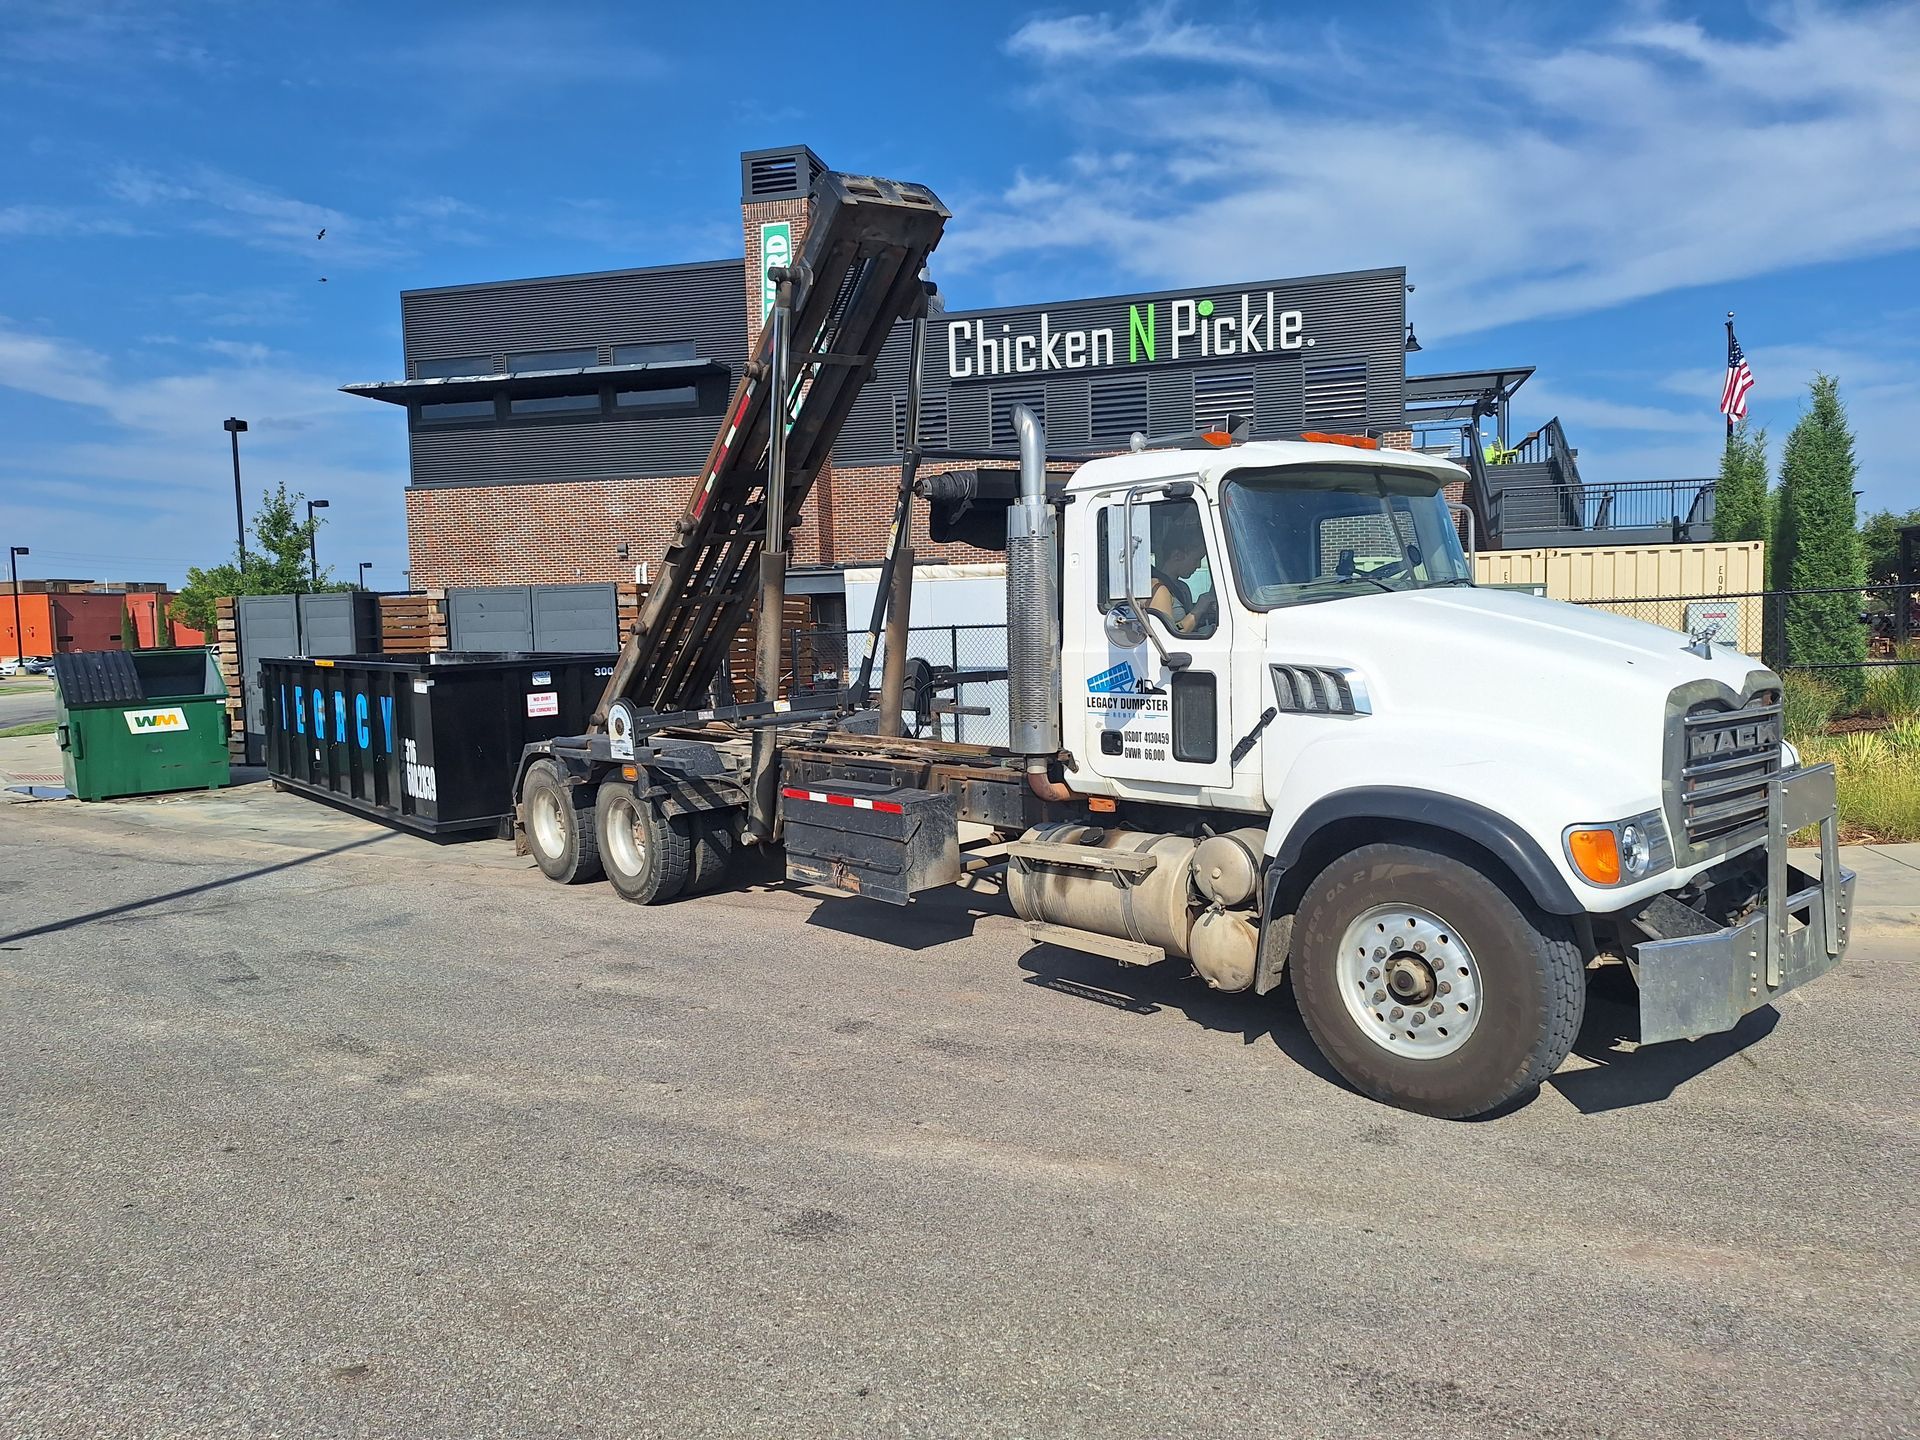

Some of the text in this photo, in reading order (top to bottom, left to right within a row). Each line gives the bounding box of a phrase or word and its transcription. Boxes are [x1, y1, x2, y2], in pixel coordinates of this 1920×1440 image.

[948, 312, 1114, 378] Chicken
[1129, 303, 1155, 363] N
[1086, 696, 1169, 712] LEGACY DUMPSTER
[134, 714, 178, 728] WM
[1124, 730, 1170, 745] USDOT 4130459
[1691, 721, 1778, 757] MACK
[1124, 747, 1142, 760] GVWR
